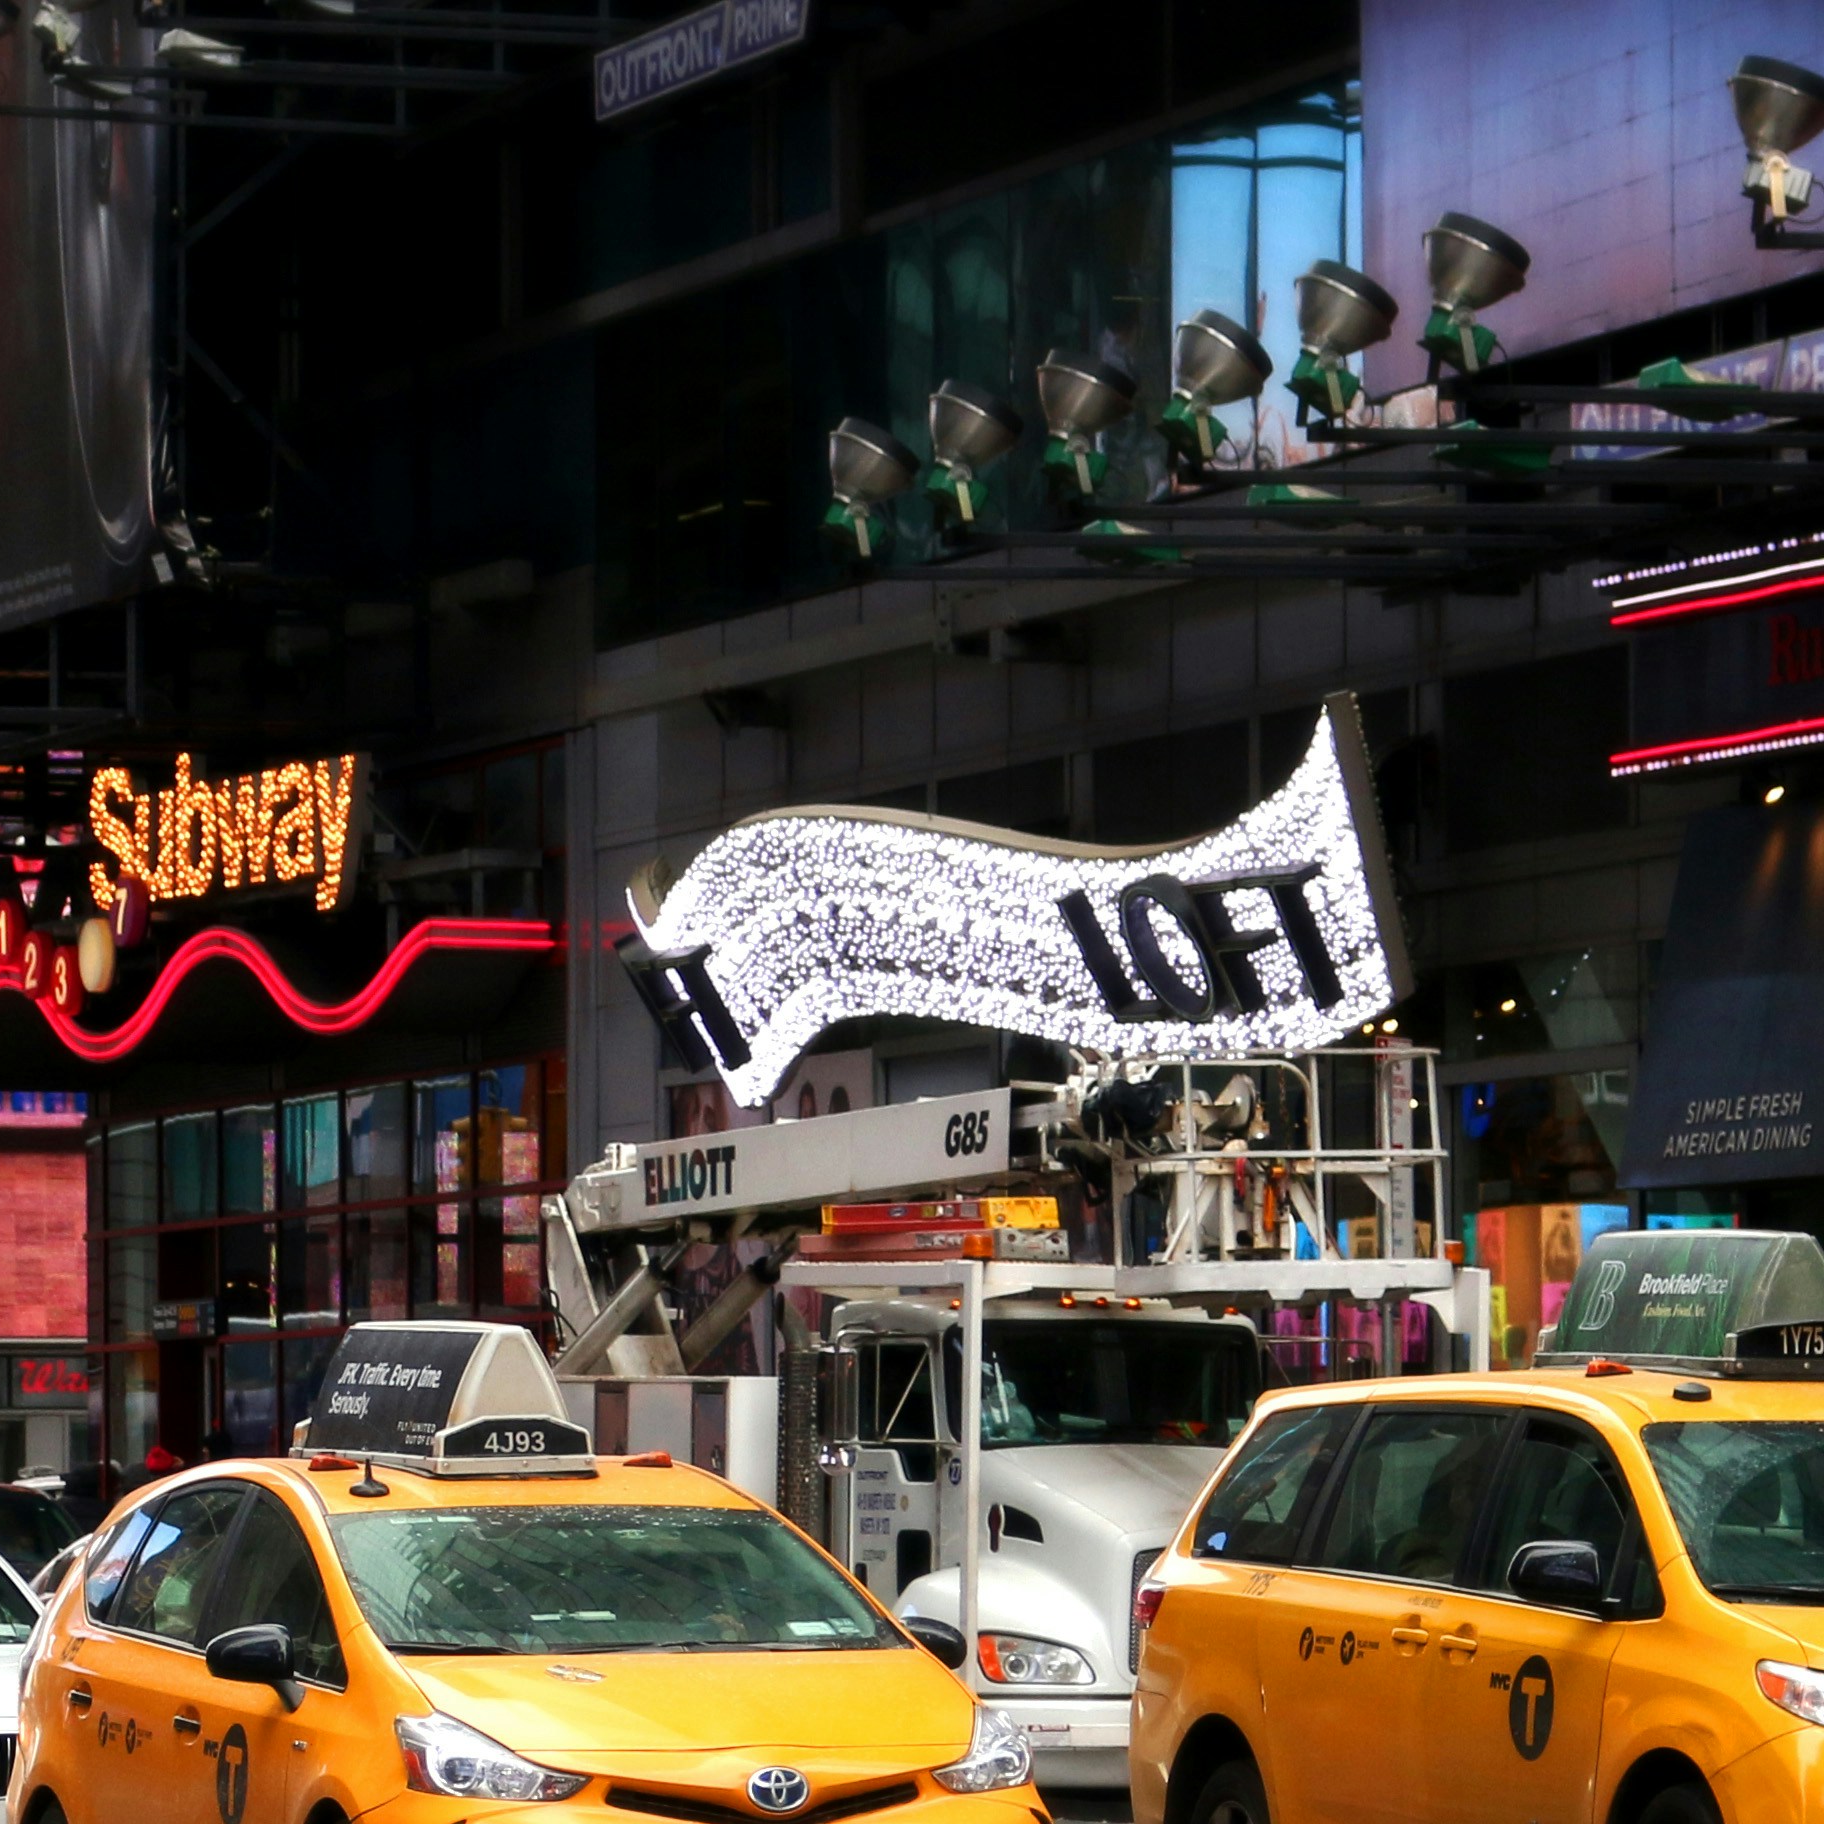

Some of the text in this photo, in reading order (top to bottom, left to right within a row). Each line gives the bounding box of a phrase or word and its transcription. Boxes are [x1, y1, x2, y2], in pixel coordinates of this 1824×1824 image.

[600, 15, 720, 107] OUTFRONT
[88, 751, 356, 912] Subway
[23, 950, 39, 988] 2
[55, 969, 67, 1005] 3
[115, 890, 128, 934] 7
[1057, 861, 1346, 1026] LOFT
[1685, 1092, 1803, 1125] SIMPLE FRESH
[944, 1110, 990, 1158] G85
[1663, 1123, 1813, 1158] AMERICAN DINING
[644, 1145, 736, 1206] ELLIOTT
[1639, 1272, 1729, 1295] Brookfield Place
[1780, 1326, 1824, 1355] 1Y75
[389, 1364, 420, 1391] Every
[328, 1391, 371, 1419] Seriously.
[484, 1431, 546, 1454] 4J93
[1489, 1671, 1511, 1691] NYC
